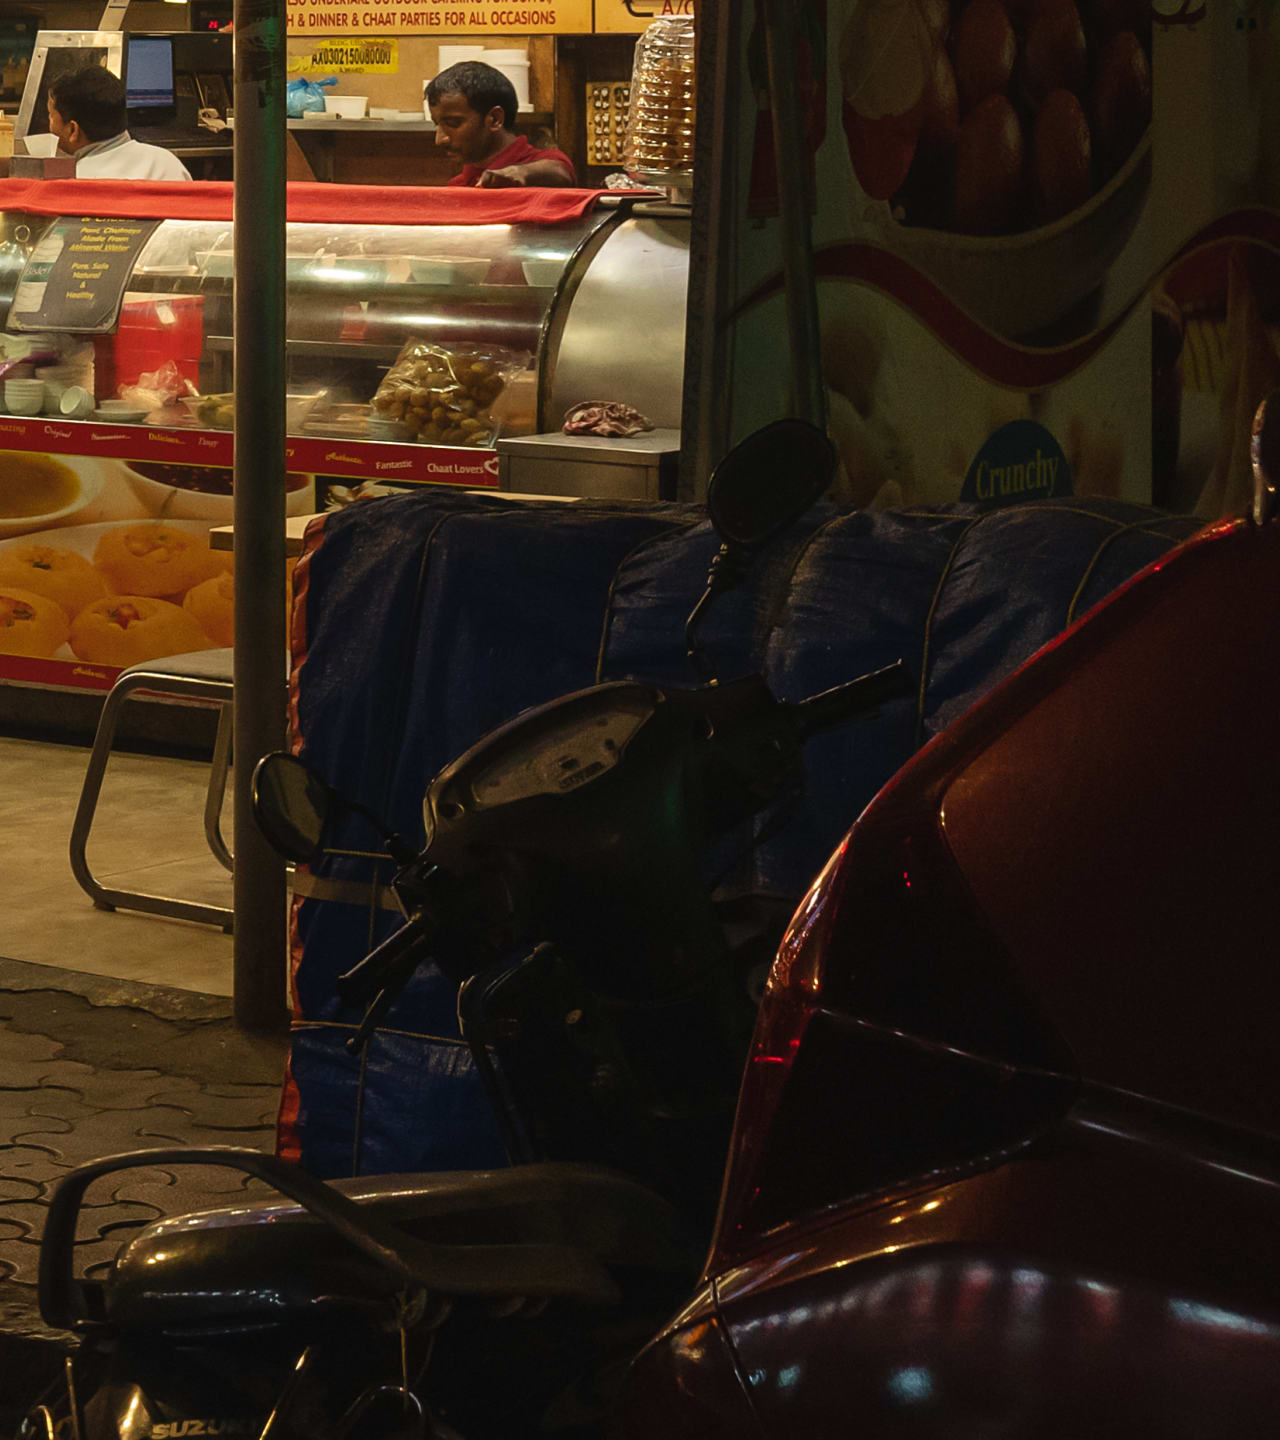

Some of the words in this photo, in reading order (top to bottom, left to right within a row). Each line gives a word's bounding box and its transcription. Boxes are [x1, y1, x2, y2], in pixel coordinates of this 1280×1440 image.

[297, 12, 306, 28] &
[309, 12, 349, 27] DINNER
[351, 12, 360, 26] &
[363, 12, 397, 27] CHAAT
[400, 11, 441, 26] PARTIES
[445, 11, 466, 26] FOR
[469, 10, 488, 25] ALL
[490, 10, 556, 26] OCCASIONS
[81, 235, 106, 243] Made
[106, 235, 130, 243] From
[69, 244, 104, 253] Mineral
[104, 244, 130, 253] Water
[92, 262, 109, 271] Safe
[72, 272, 102, 280] Natural
[79, 280, 86, 289] &
[66, 291, 95, 301] Healthy
[376, 460, 413, 471] Fantastic
[426, 463, 453, 474] Chaat
[454, 464, 484, 475] Lovers
[975, 450, 1060, 501] Crunchy
